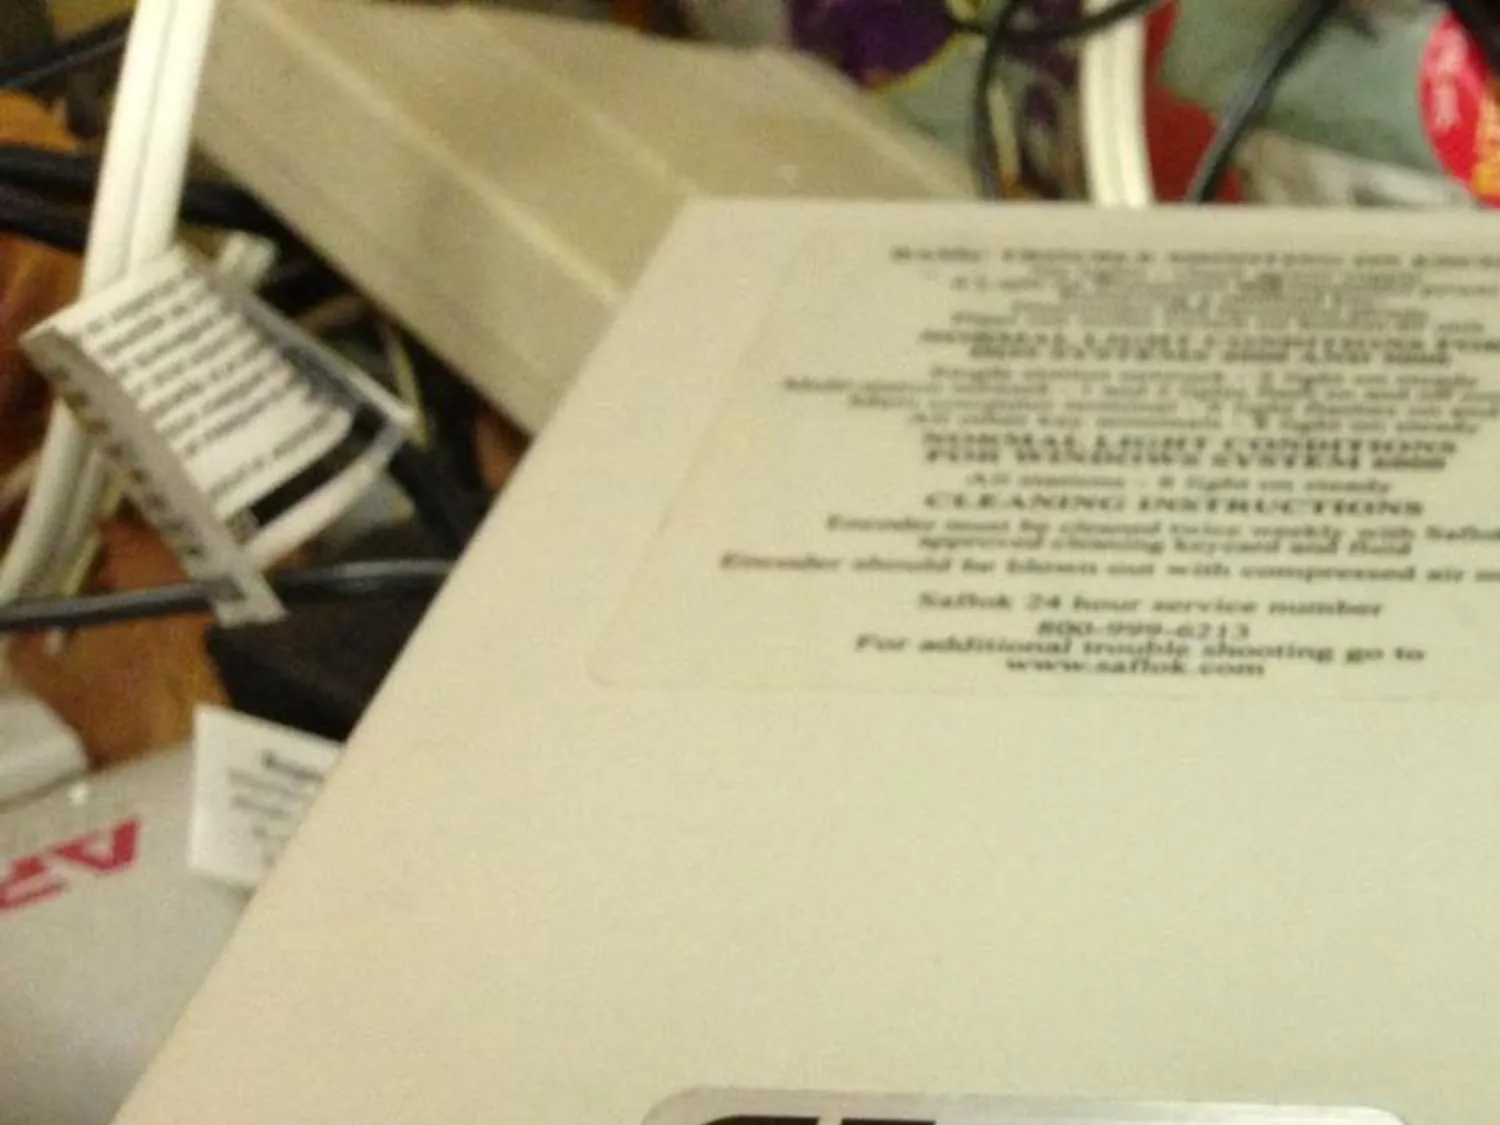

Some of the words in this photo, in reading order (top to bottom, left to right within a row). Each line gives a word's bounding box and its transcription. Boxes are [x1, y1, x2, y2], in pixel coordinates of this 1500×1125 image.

[923, 492, 1127, 511] CLEANING
[1138, 496, 1425, 517] INSTRUCTIONS
[1024, 591, 1063, 611] 24
[1071, 592, 1143, 613] hour
[1150, 596, 1259, 615] service
[1267, 598, 1385, 618] number
[854, 632, 909, 654] For
[917, 633, 1073, 655] additional
[1344, 646, 1385, 667] go
[1393, 645, 1427, 663] to
